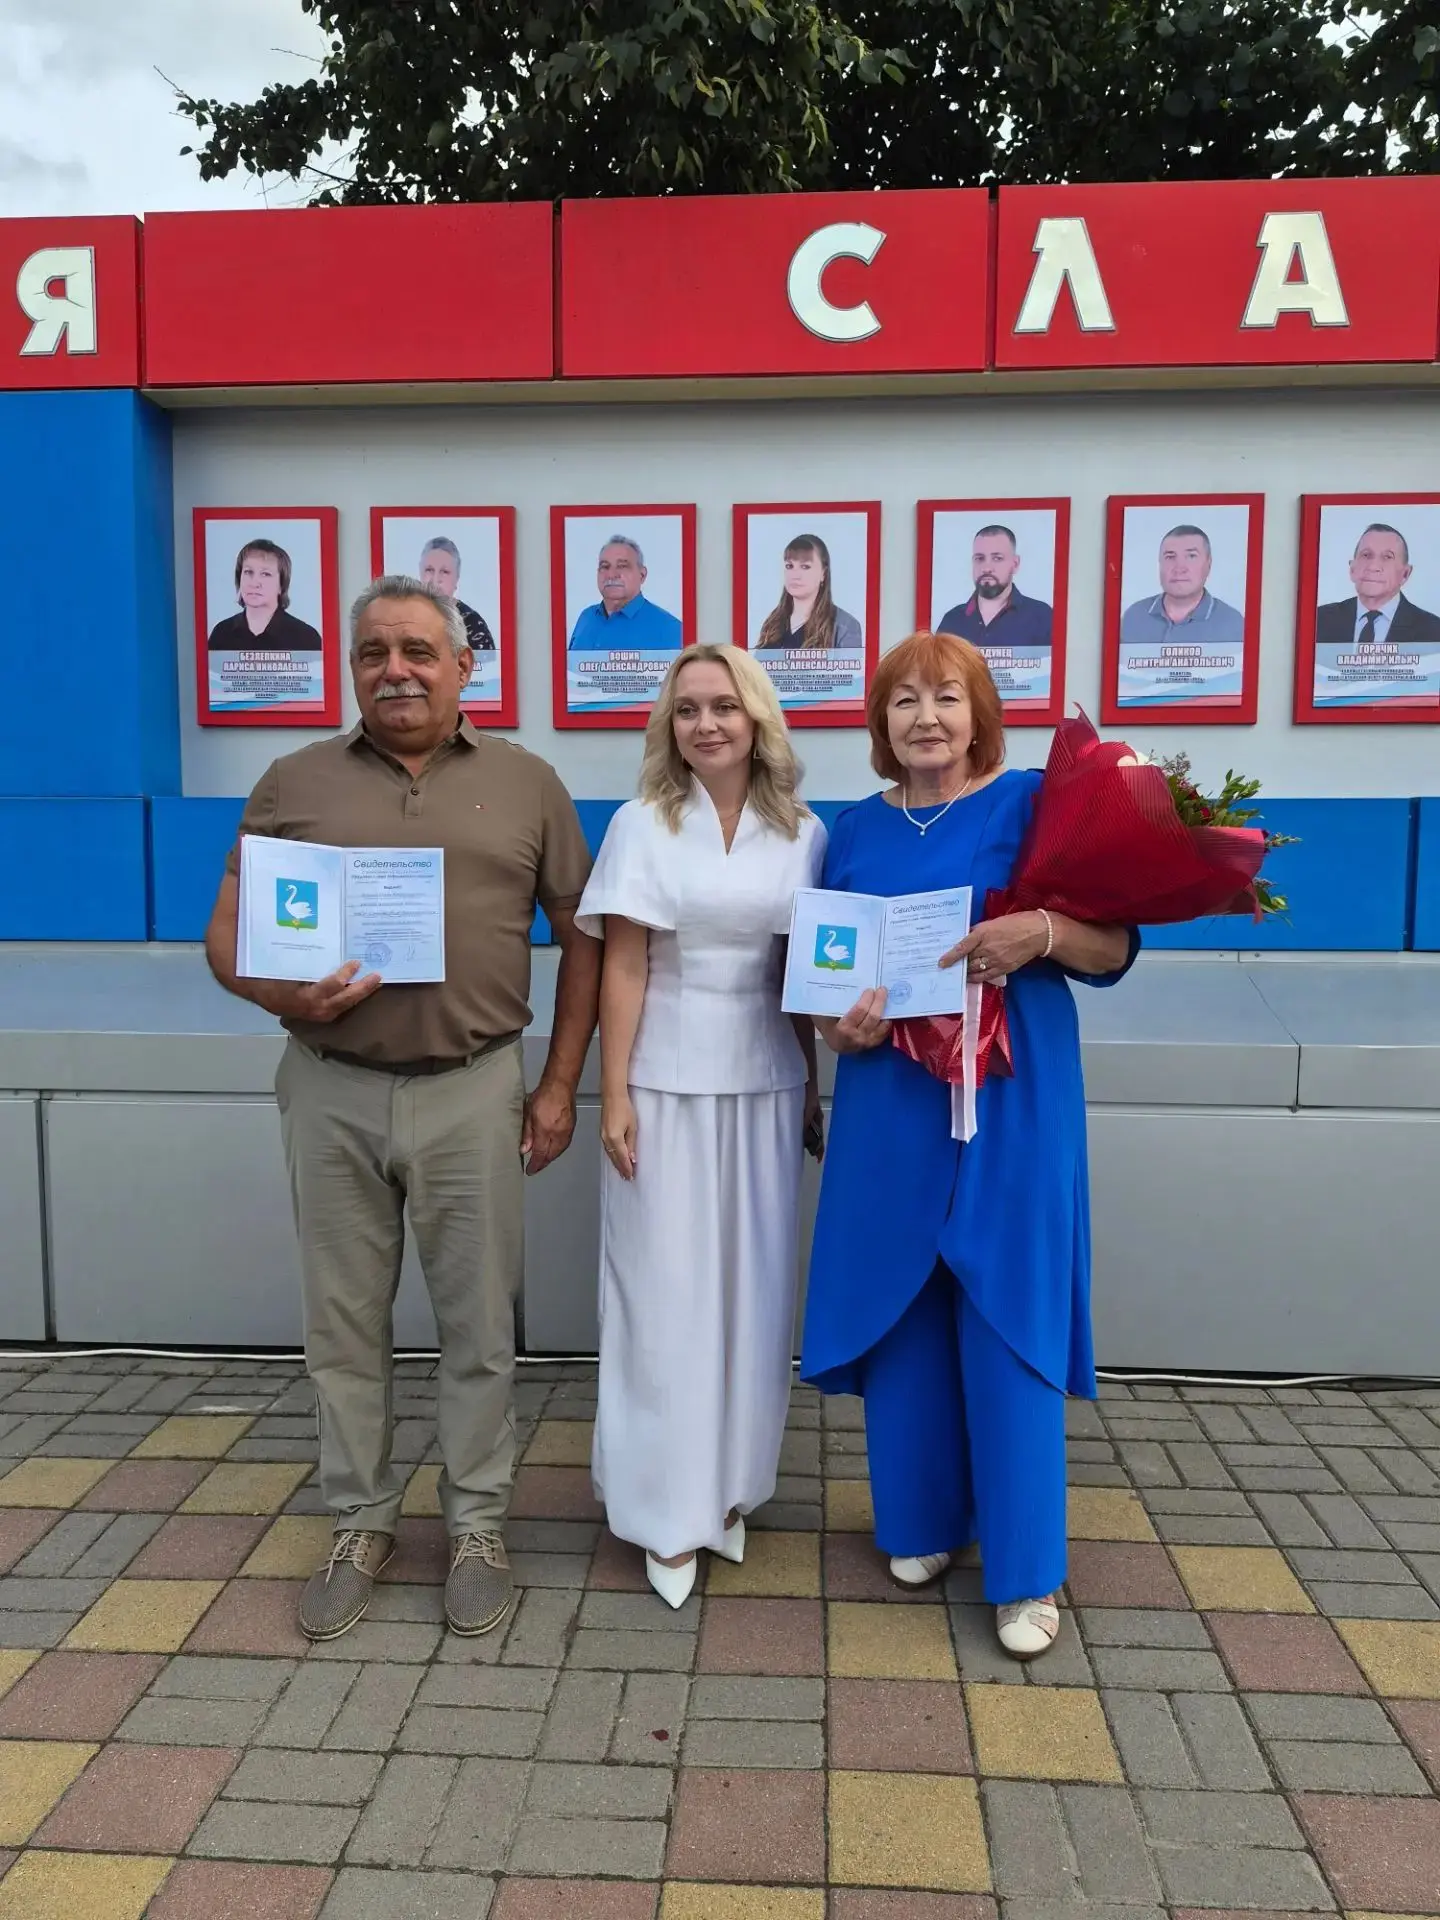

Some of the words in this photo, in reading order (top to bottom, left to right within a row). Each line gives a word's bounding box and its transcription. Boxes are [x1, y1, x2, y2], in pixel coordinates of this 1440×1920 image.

[16, 246, 97, 356] Я
[1161, 646, 1201, 657] ГОЛИКОВ
[789, 660, 861, 671] АЛЕКСАНДРОВНА
[987, 658, 1041, 669] ДИМИРОВИЧ
[1171, 656, 1235, 668] АНАТОЛЬЕВИЧ
[1337, 655, 1387, 666] ВЛАДИМИР
[1388, 655, 1420, 665] ИЛЬИЧ
[223, 662, 255, 672] ЛАРИСА
[256, 661, 308, 672] НИКОЛАЕВНА
[579, 662, 600, 672] ОЛЕГ
[353, 859, 432, 868] Свидетельство
[892, 899, 960, 915] Свидетельство
